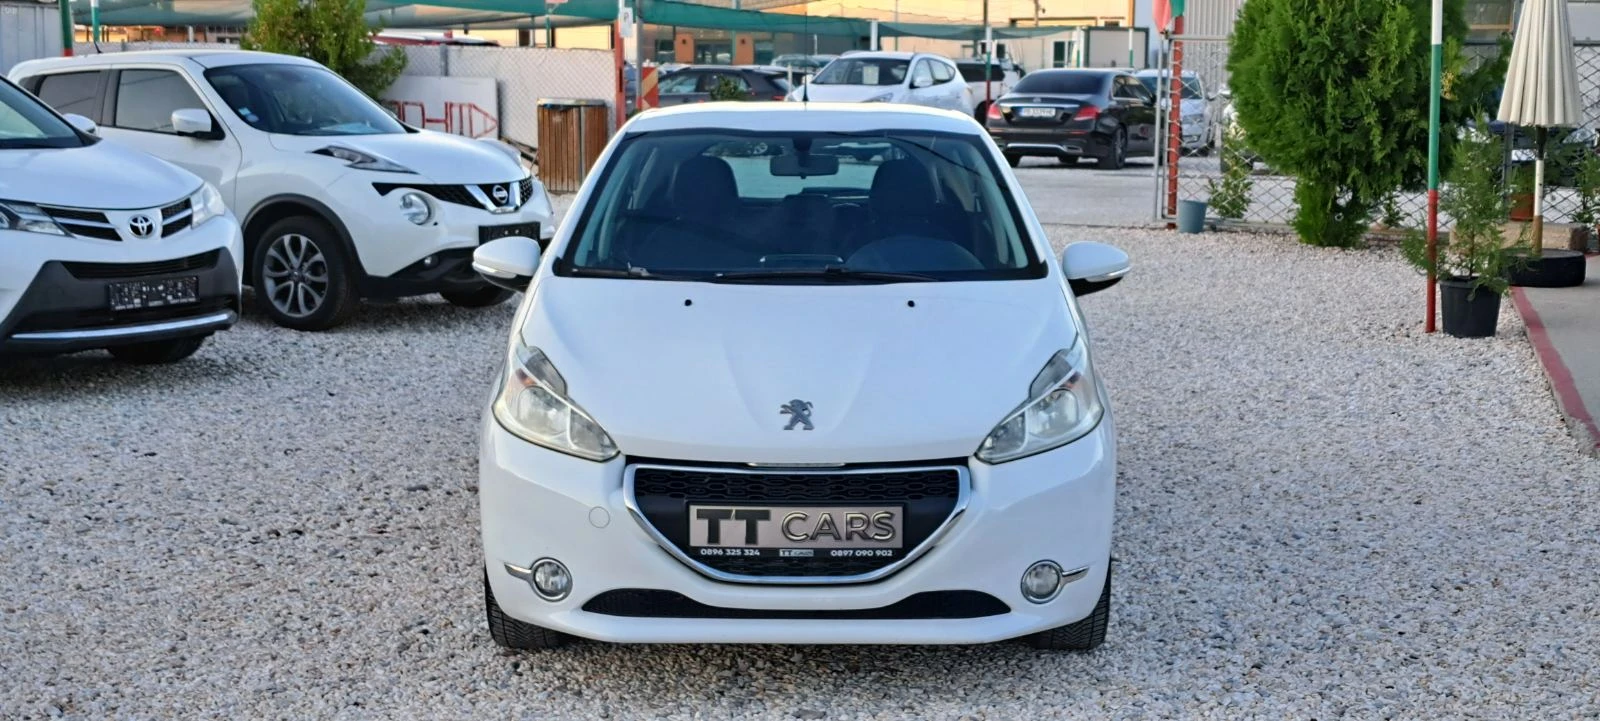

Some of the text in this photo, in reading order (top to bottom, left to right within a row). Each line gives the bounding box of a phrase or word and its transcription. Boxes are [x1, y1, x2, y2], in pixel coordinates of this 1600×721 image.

[696, 509, 896, 545] TT CARS
[700, 548, 760, 556] 0896 325 324
[830, 549, 893, 557] 0897 090 902
